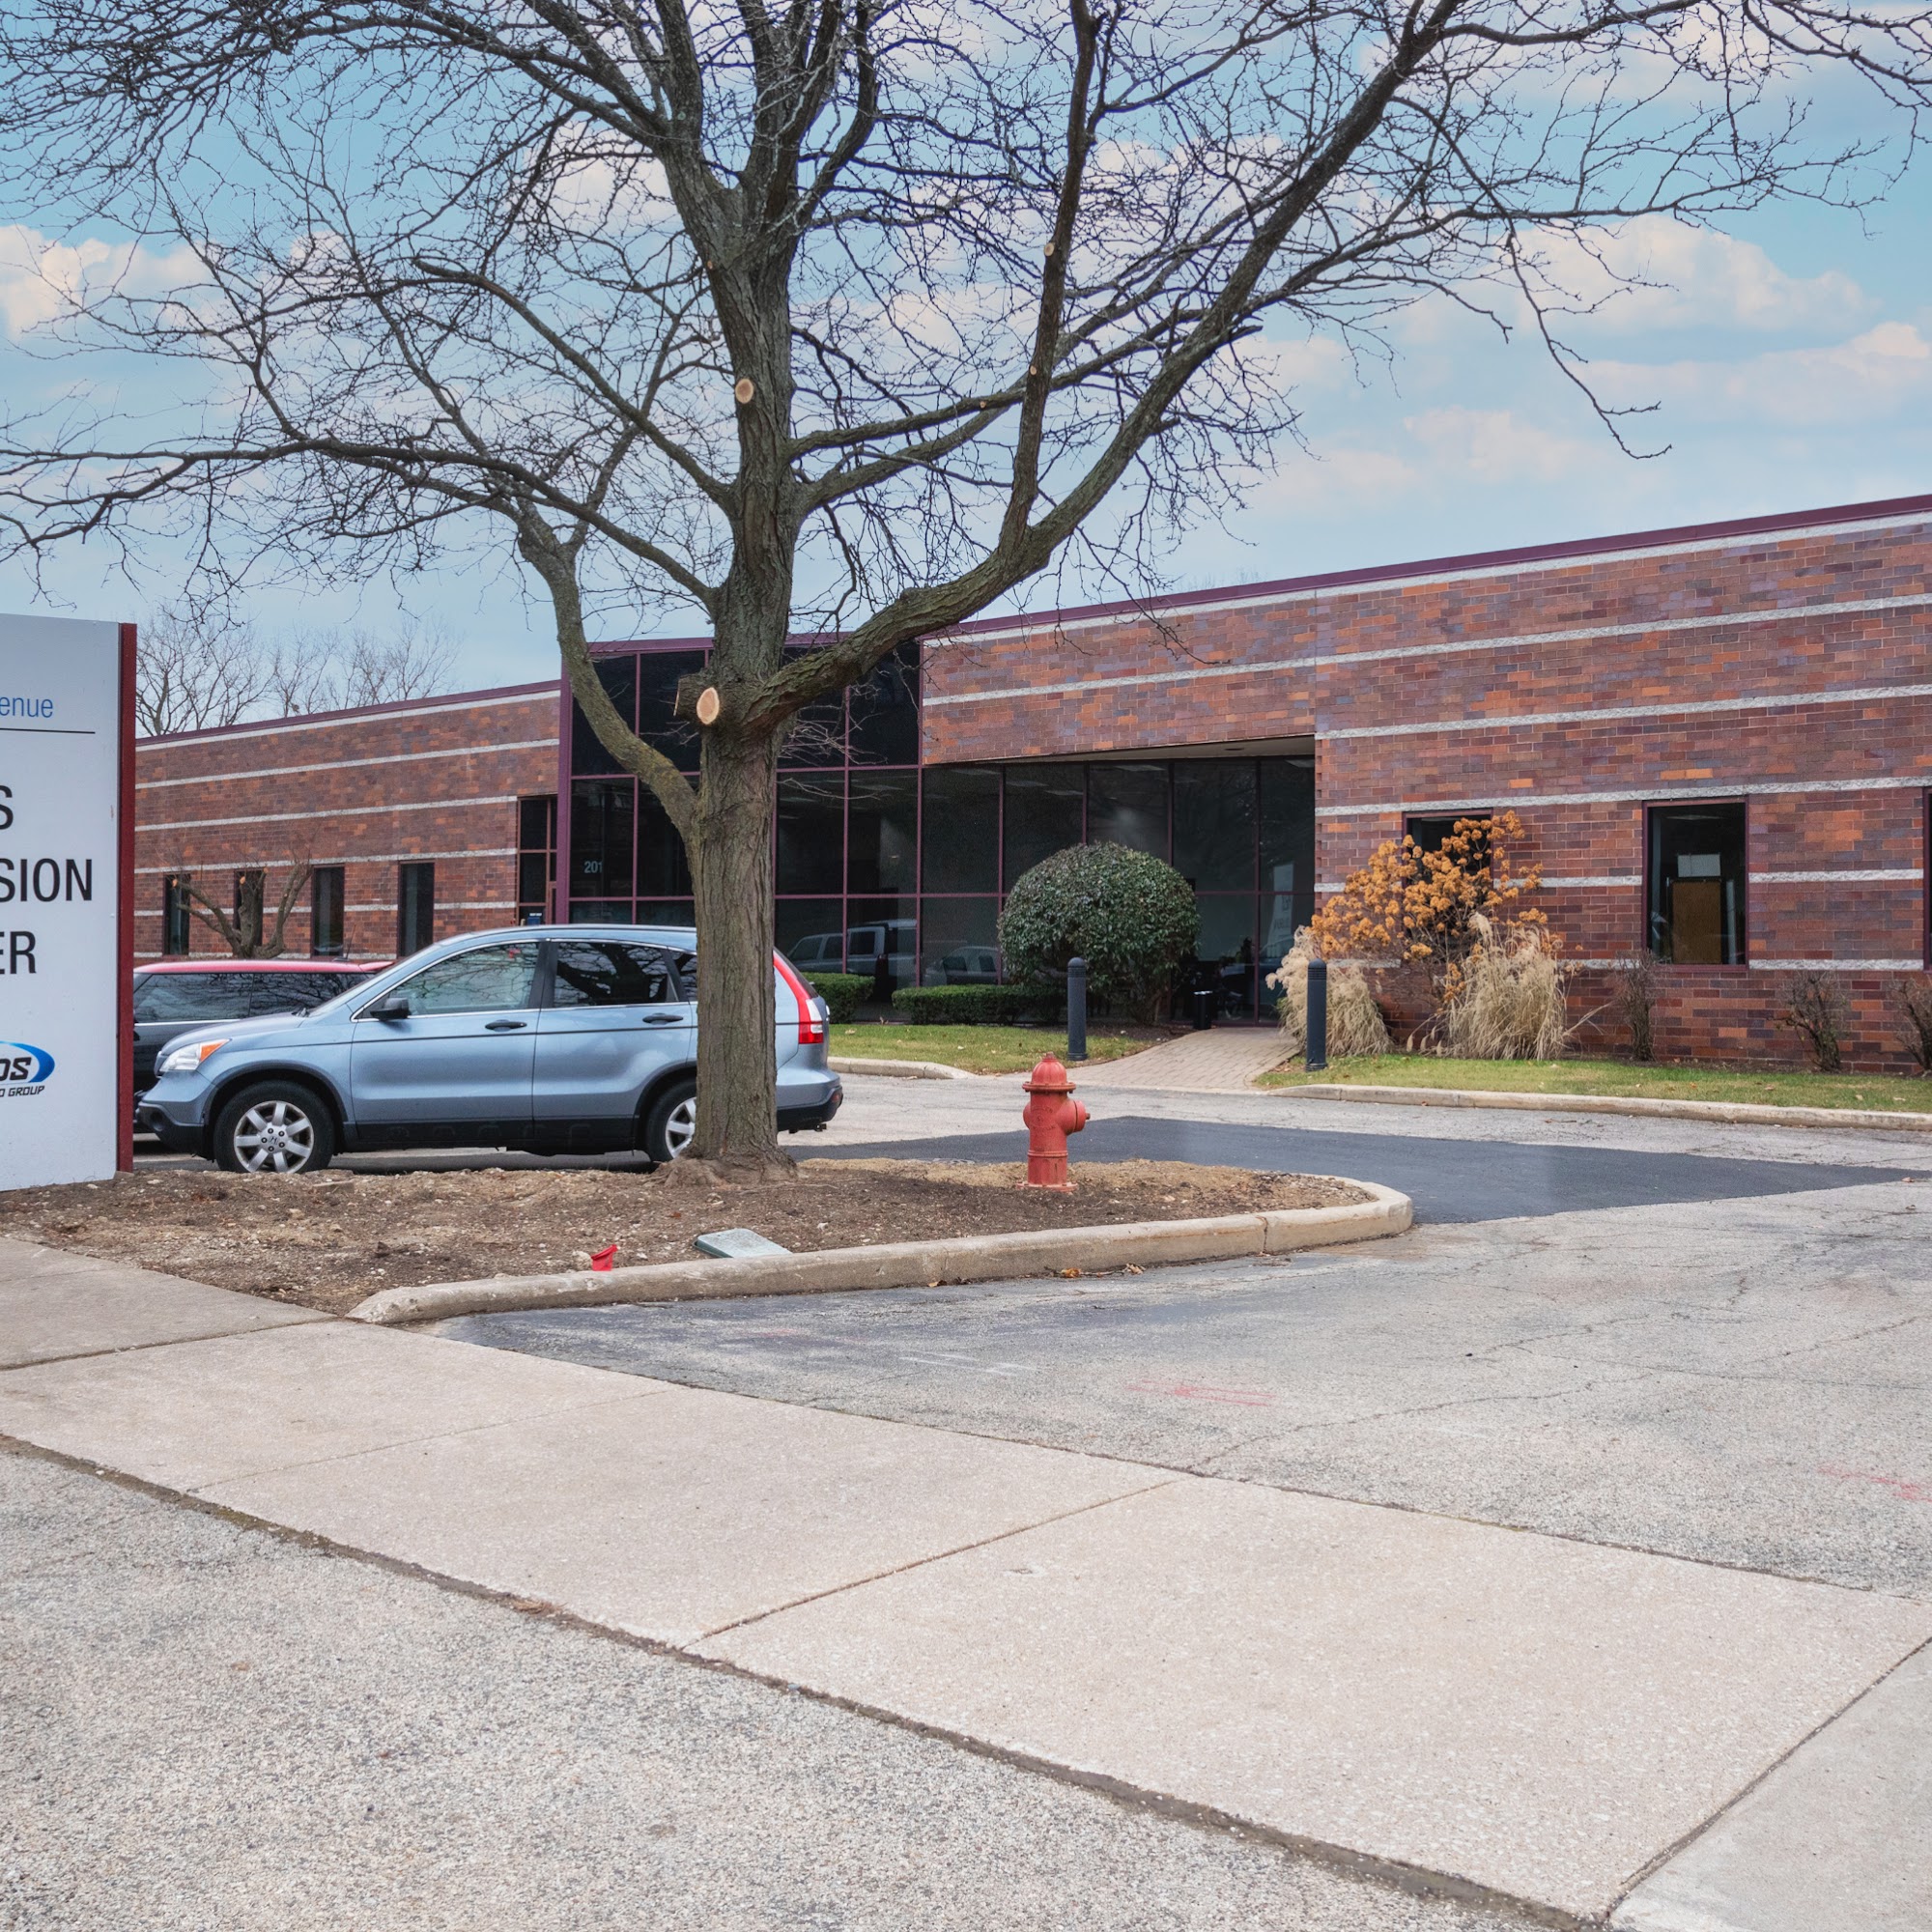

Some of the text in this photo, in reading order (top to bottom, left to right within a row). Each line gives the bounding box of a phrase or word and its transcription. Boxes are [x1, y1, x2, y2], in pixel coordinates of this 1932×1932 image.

[0, 696, 53, 718] enue
[583, 860, 603, 873] 201
[0, 858, 93, 902] SION
[0, 930, 37, 975] R
[8, 1085, 45, 1096] GROUP
